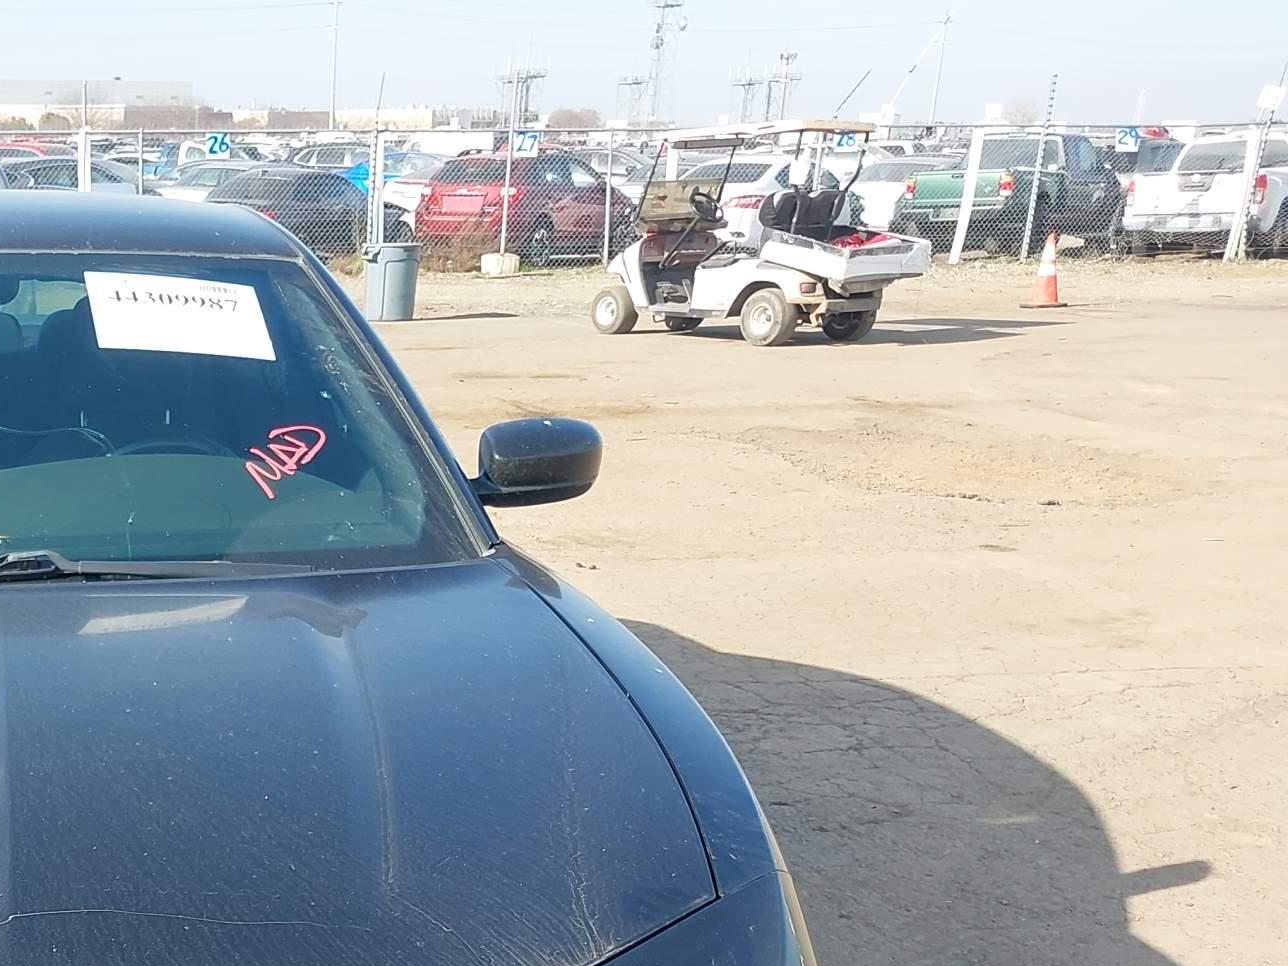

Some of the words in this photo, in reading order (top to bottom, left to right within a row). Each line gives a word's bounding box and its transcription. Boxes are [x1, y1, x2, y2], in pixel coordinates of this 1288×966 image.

[207, 132, 229, 154] 26
[516, 131, 538, 152] 27
[1118, 127, 1138, 147] 29
[108, 289, 238, 312] 44309987
